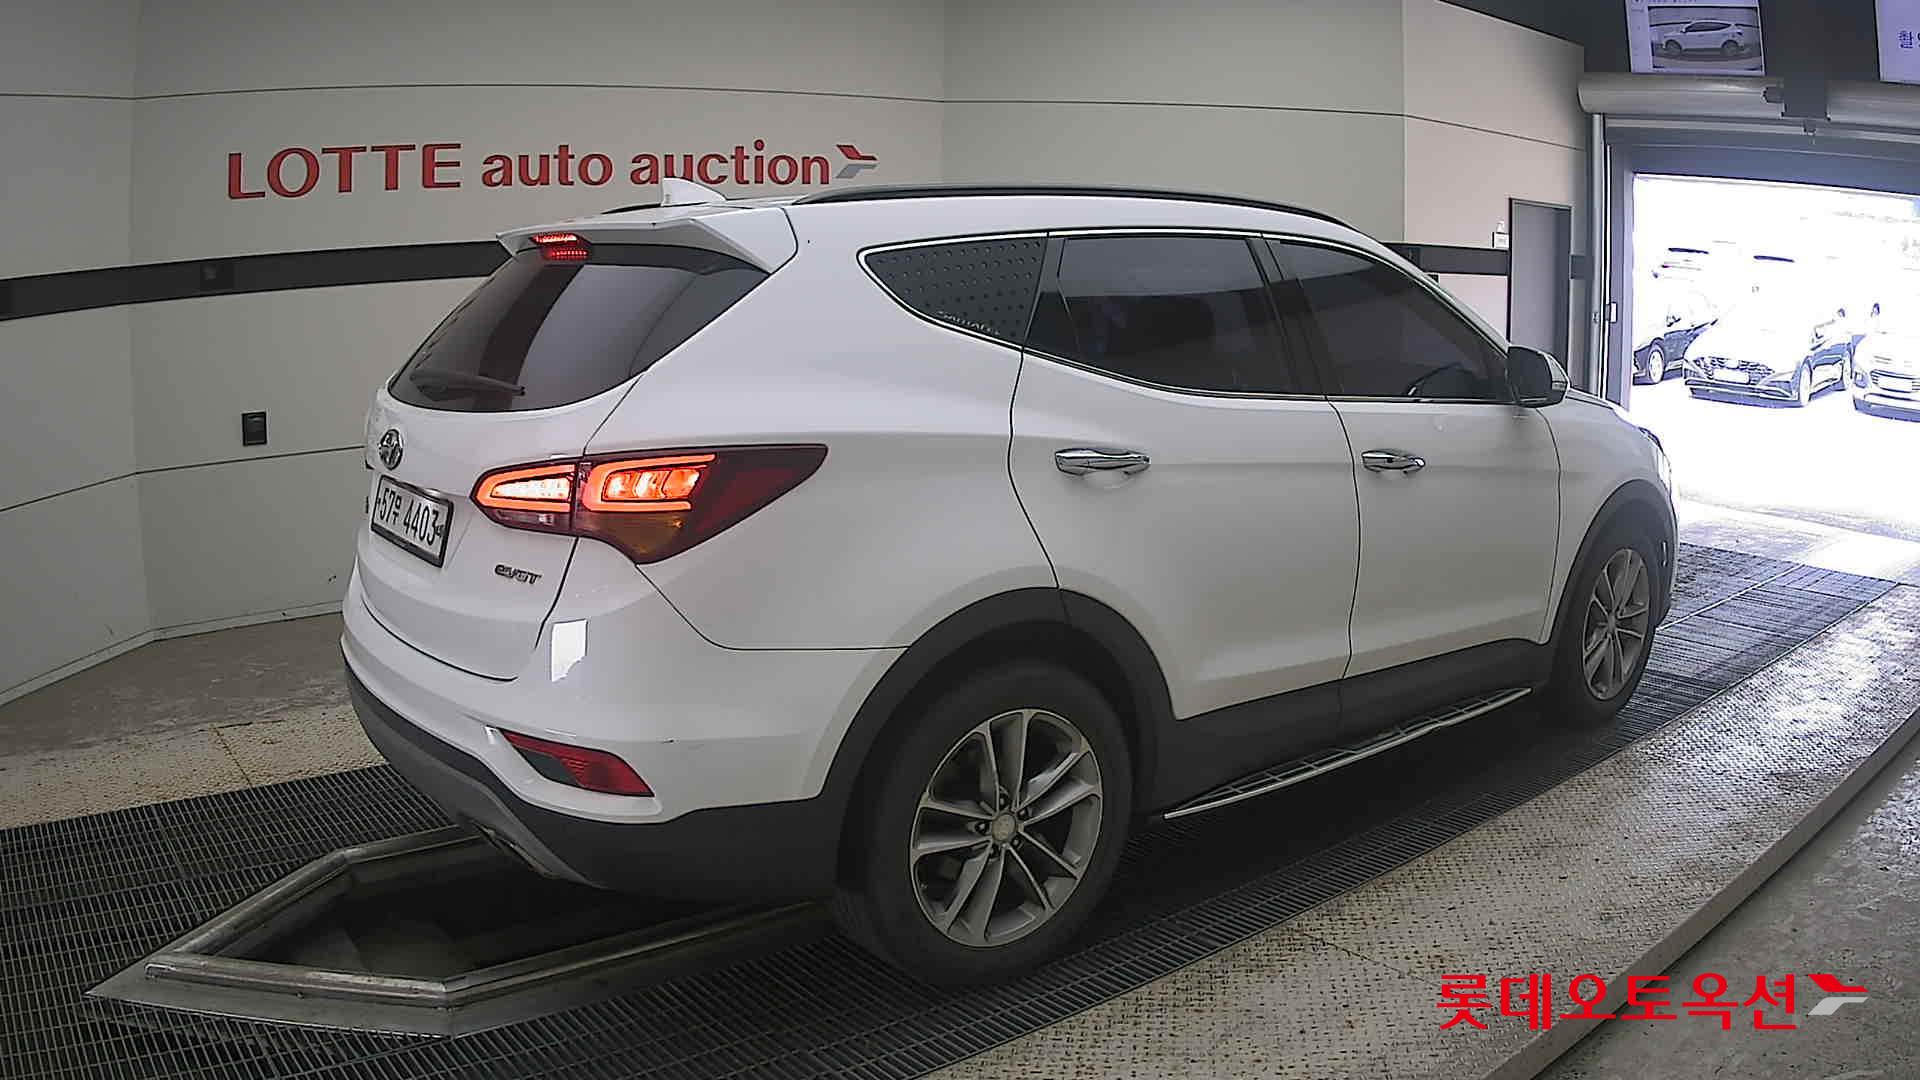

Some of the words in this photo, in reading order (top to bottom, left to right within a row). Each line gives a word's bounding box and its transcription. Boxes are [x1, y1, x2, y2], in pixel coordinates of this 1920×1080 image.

[228, 143, 462, 200] LOTTE
[482, 147, 613, 187] auto
[630, 139, 831, 187] auction
[403, 498, 440, 546] 4403
